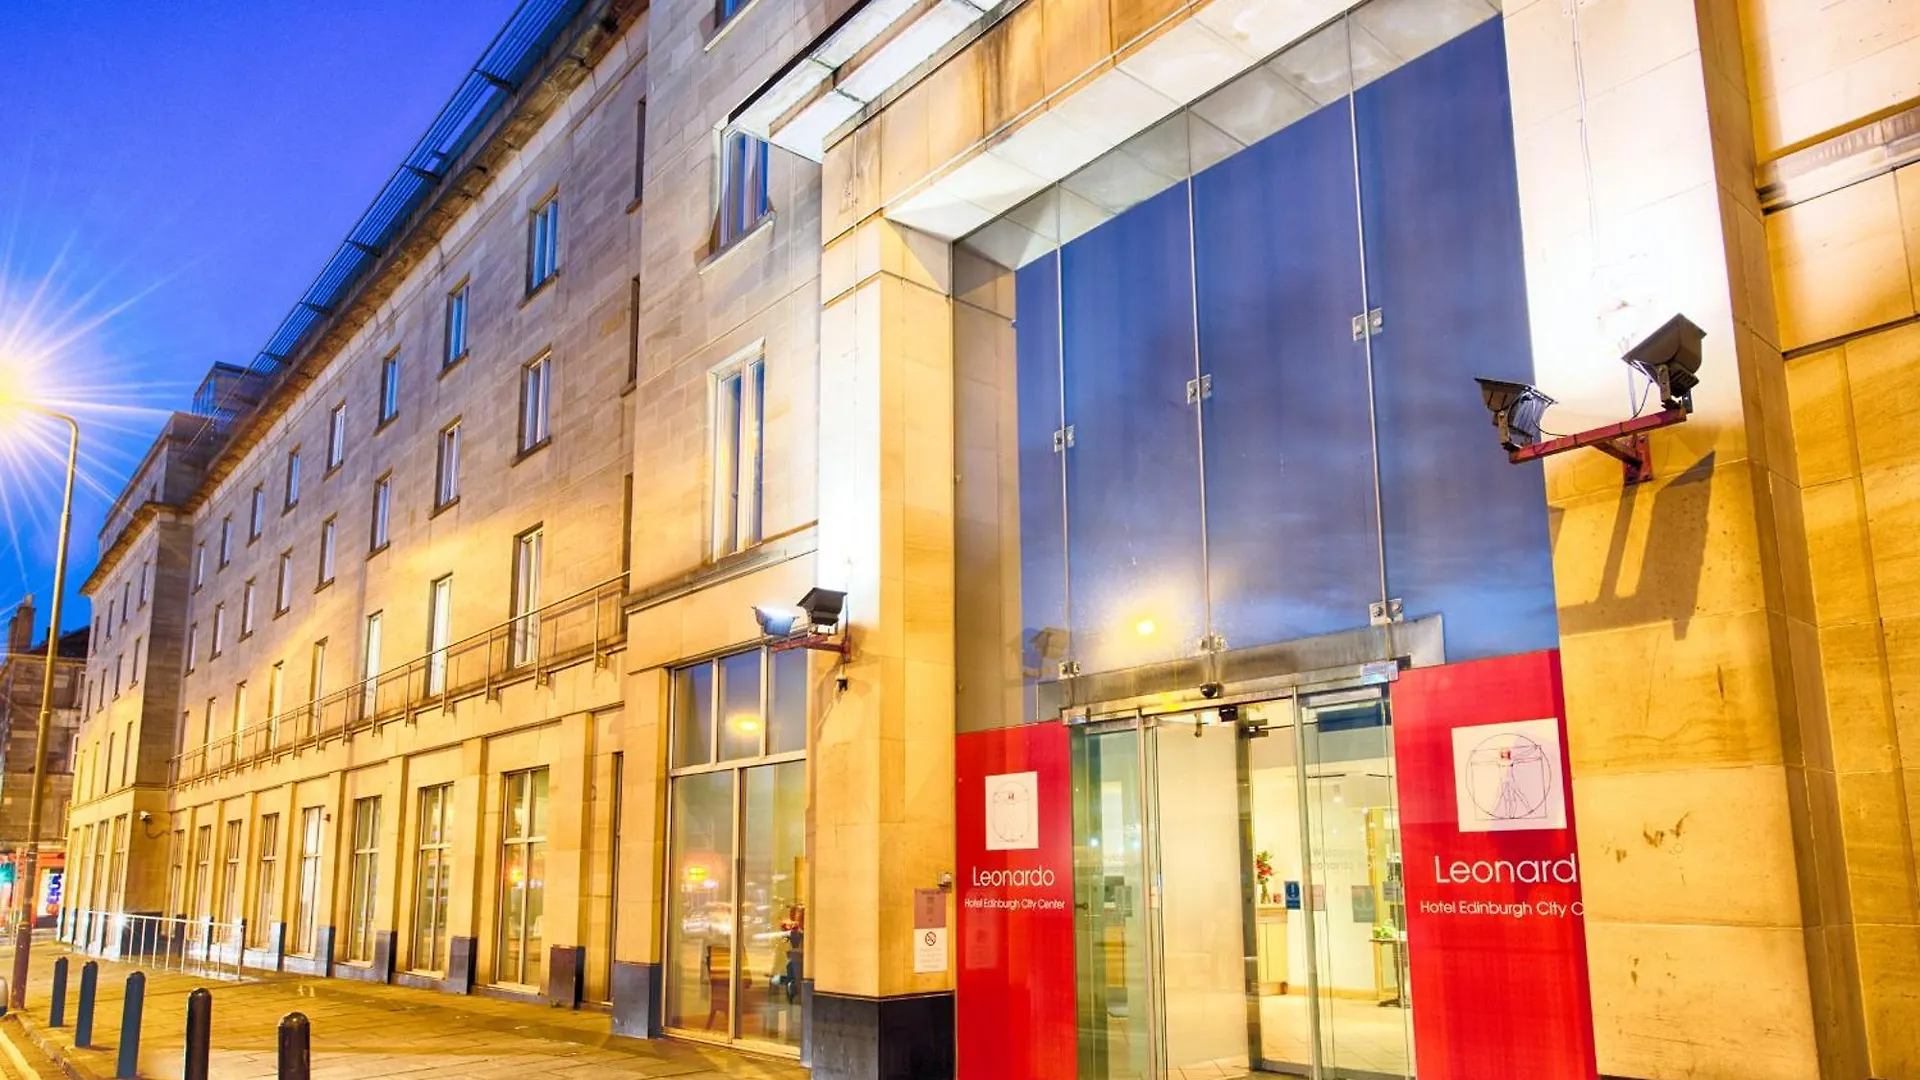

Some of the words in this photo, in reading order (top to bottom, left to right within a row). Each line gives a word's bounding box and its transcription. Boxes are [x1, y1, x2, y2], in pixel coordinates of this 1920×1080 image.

[972, 865, 1055, 887] Leonardo
[1434, 853, 1578, 884] Leonard
[964, 899, 983, 909] Hotel
[984, 899, 1020, 911] Edinburgh
[1021, 899, 1037, 911] City
[1038, 899, 1065, 910] Center
[1420, 901, 1456, 914] Hotel
[1459, 901, 1533, 919] Edinburgh
[1536, 901, 1567, 918] City
